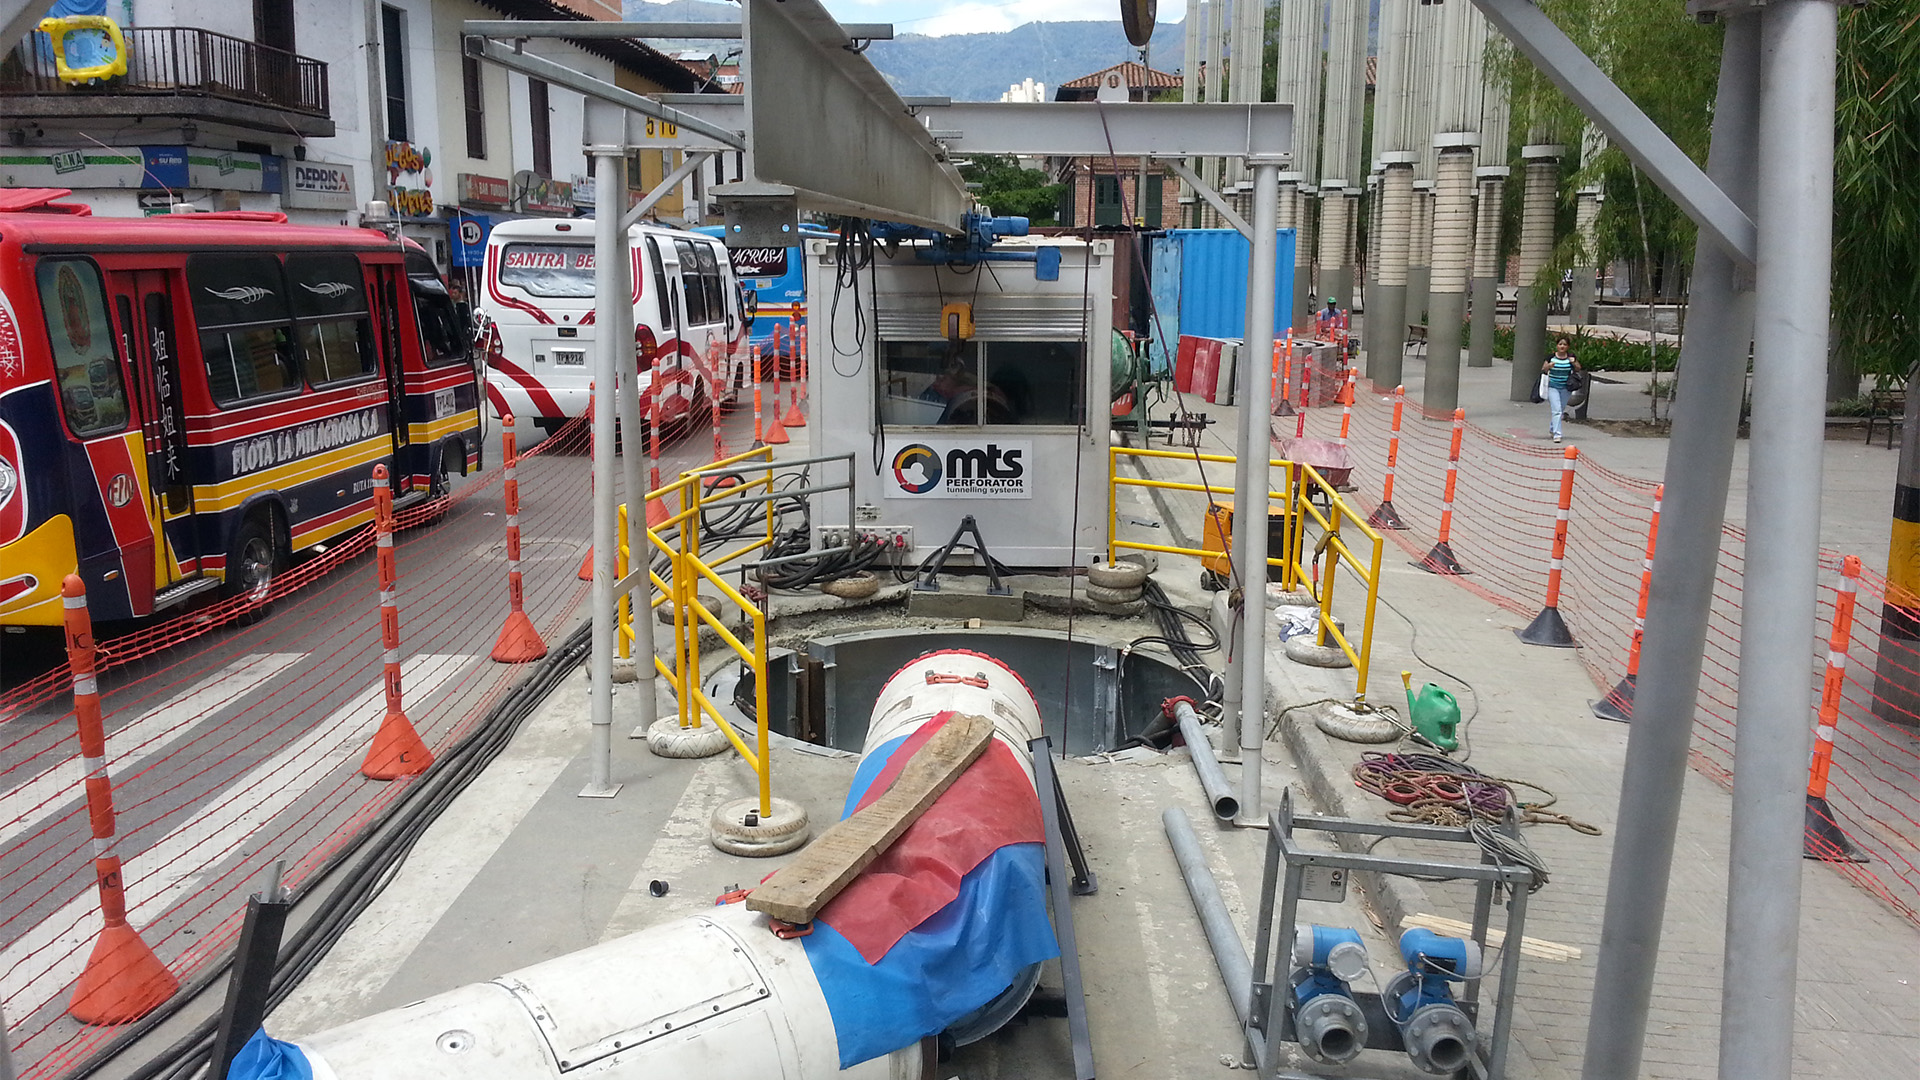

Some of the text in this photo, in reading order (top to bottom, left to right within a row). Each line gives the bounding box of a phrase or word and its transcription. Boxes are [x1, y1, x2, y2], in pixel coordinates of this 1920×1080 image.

[55, 152, 83, 168] GANA
[386, 143, 420, 171] UEGOS
[295, 166, 350, 192] DEPRISA
[505, 252, 566, 269] SANTRA
[729, 247, 785, 265] AGROSA
[232, 434, 276, 475] FLOTA
[276, 429, 295, 461] LA
[295, 411, 361, 456] MILAGROSA
[946, 444, 1023, 478] mts
[946, 479, 1023, 487] PERFORATOR
[947, 486, 988, 494] tunnelling
